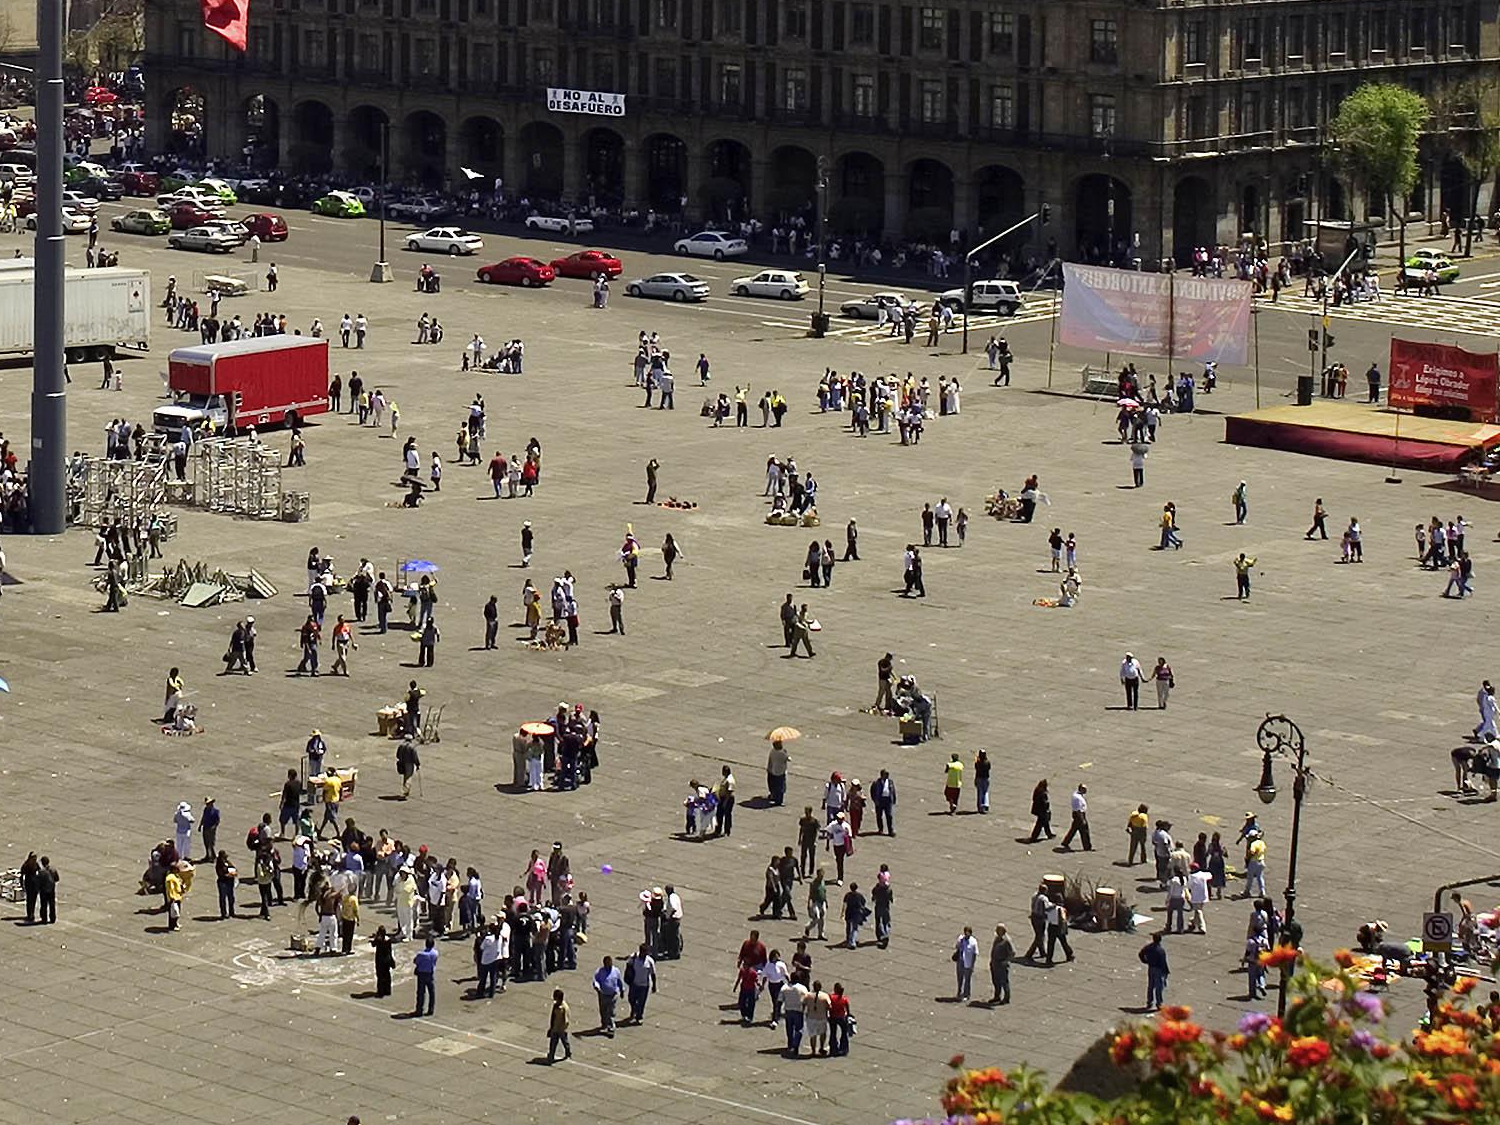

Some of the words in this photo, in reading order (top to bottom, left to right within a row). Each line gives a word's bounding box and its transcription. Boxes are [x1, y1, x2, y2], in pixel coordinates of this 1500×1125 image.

[563, 90, 580, 101] NO
[588, 92, 605, 103] AL
[549, 100, 622, 115] DESAFUERO
